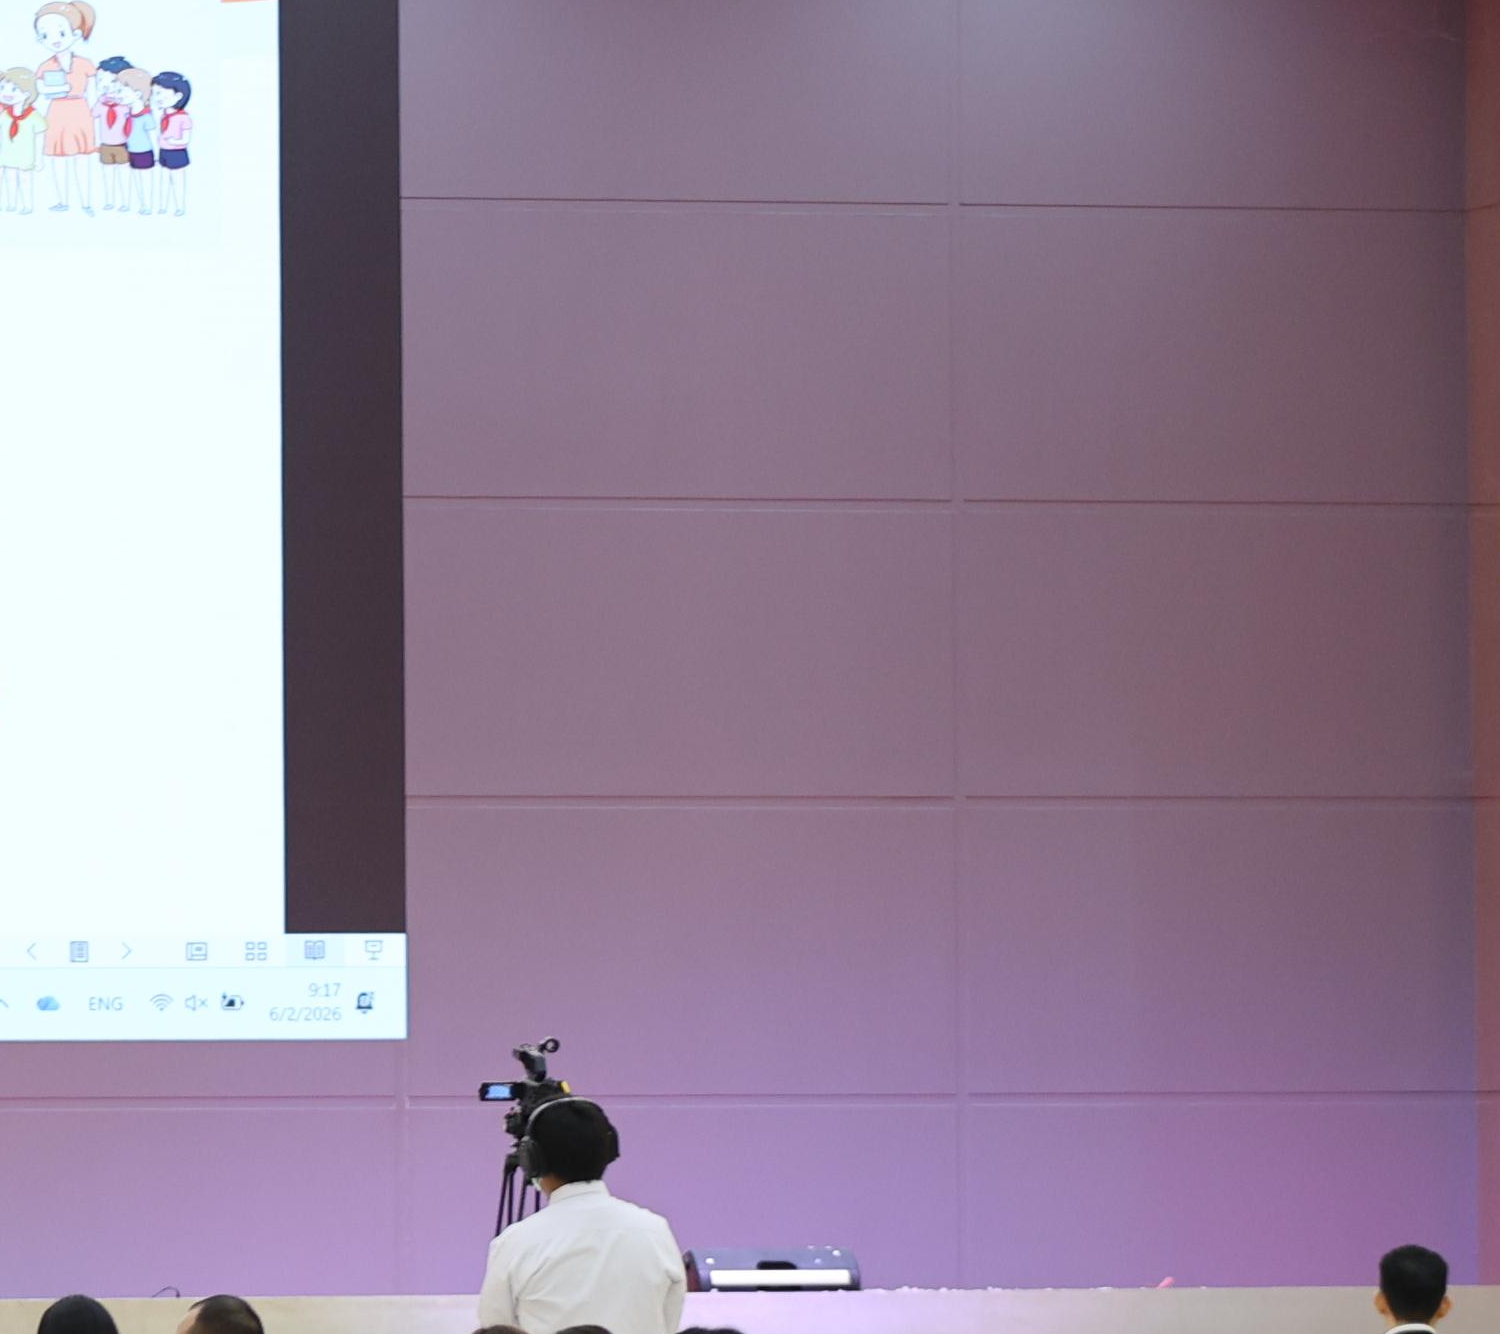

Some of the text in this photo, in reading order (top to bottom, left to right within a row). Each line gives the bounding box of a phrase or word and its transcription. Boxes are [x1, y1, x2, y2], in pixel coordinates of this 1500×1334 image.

[308, 982, 341, 998] 9:17
[88, 996, 124, 1012] ENG
[269, 1006, 343, 1022] 6/2/2026
